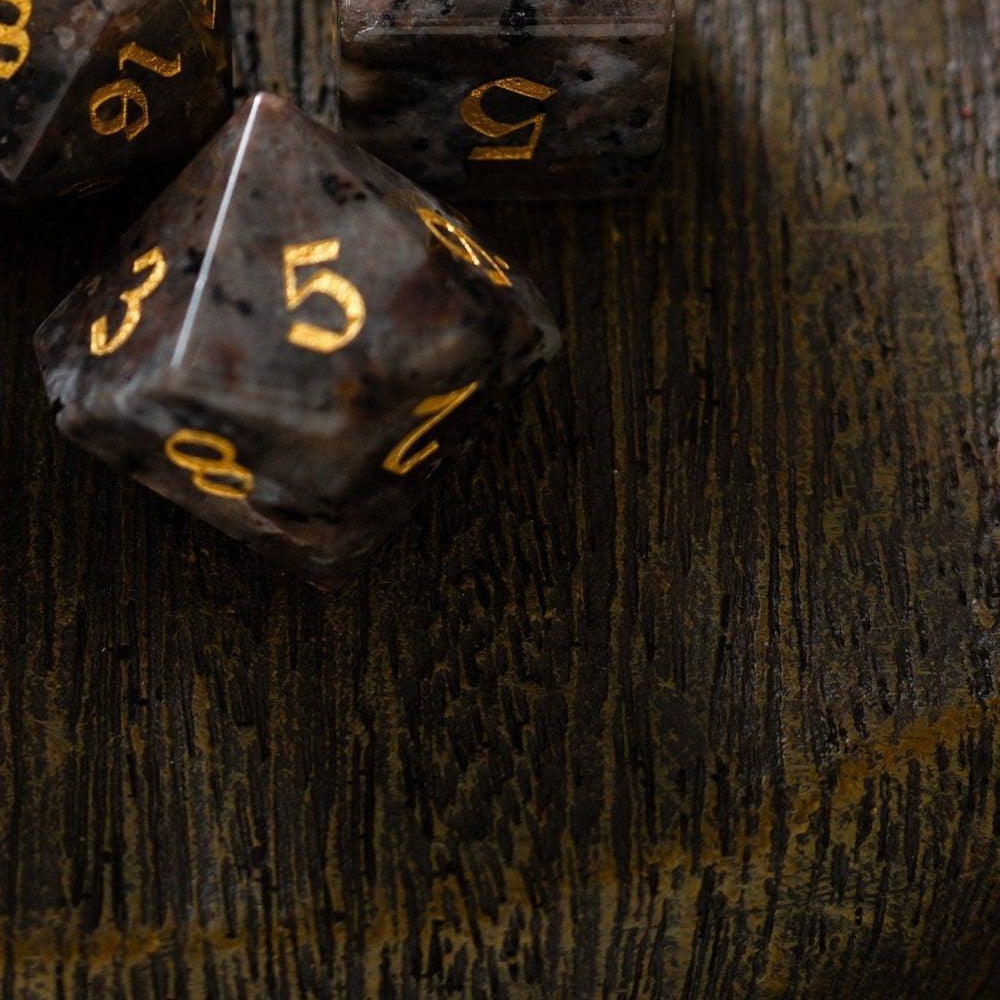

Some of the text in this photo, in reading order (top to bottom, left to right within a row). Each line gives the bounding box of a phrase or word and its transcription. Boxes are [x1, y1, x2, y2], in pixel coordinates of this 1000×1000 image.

[459, 76, 559, 161] 5
[90, 246, 168, 357] 3
[282, 237, 366, 355] 5
[165, 428, 256, 500] 8
